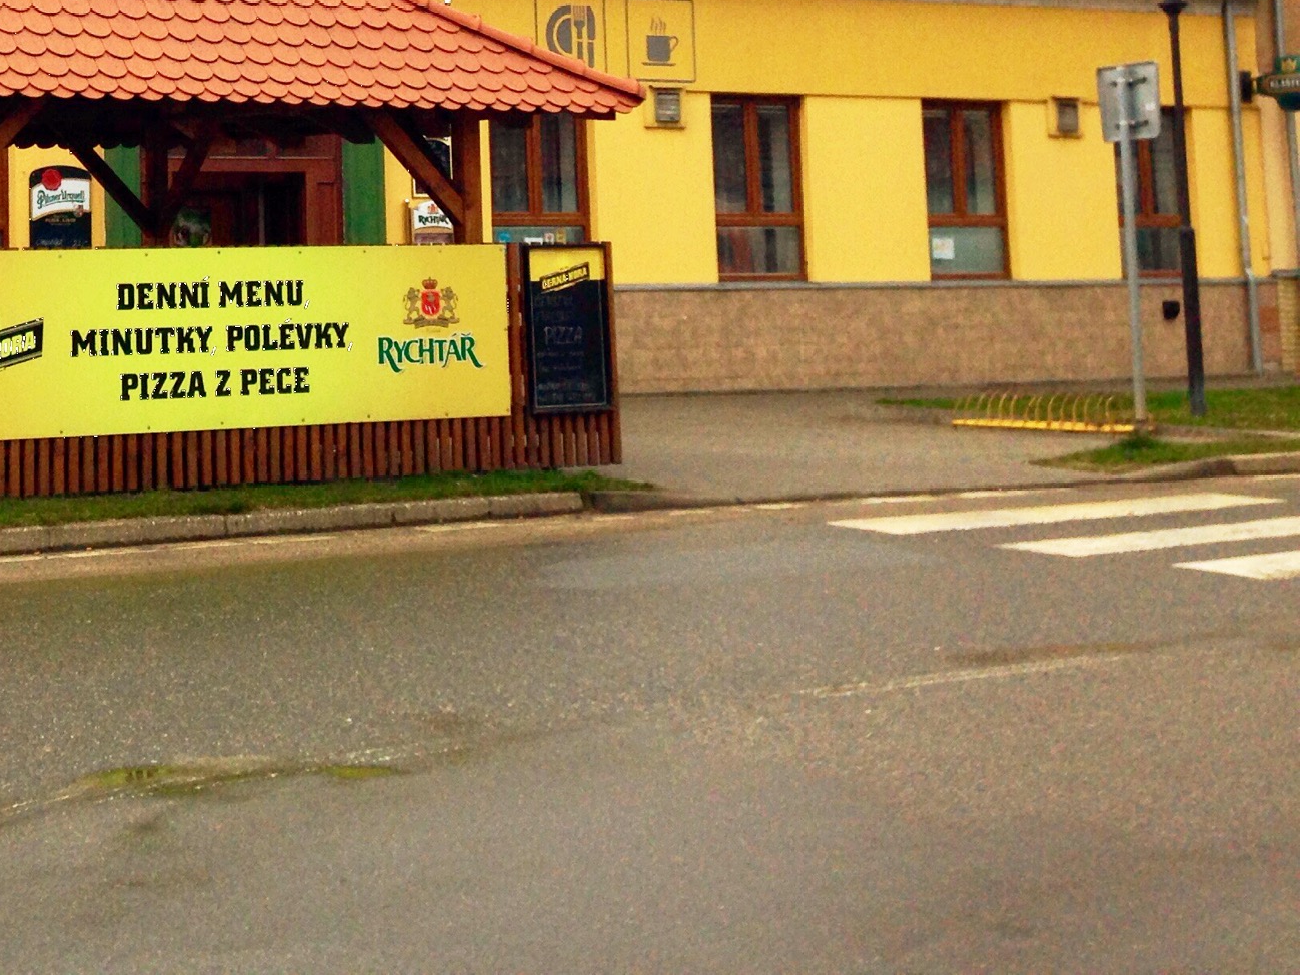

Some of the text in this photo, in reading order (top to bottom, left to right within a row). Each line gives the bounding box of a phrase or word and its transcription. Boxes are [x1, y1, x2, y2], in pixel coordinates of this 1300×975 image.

[116, 276, 310, 310] DENNÍ MENU,
[70, 318, 354, 357] MINUTKY, POLÉVKY,
[378, 333, 483, 373] RYCHTÁŘ
[120, 367, 310, 401] PIZZA Z PECE
